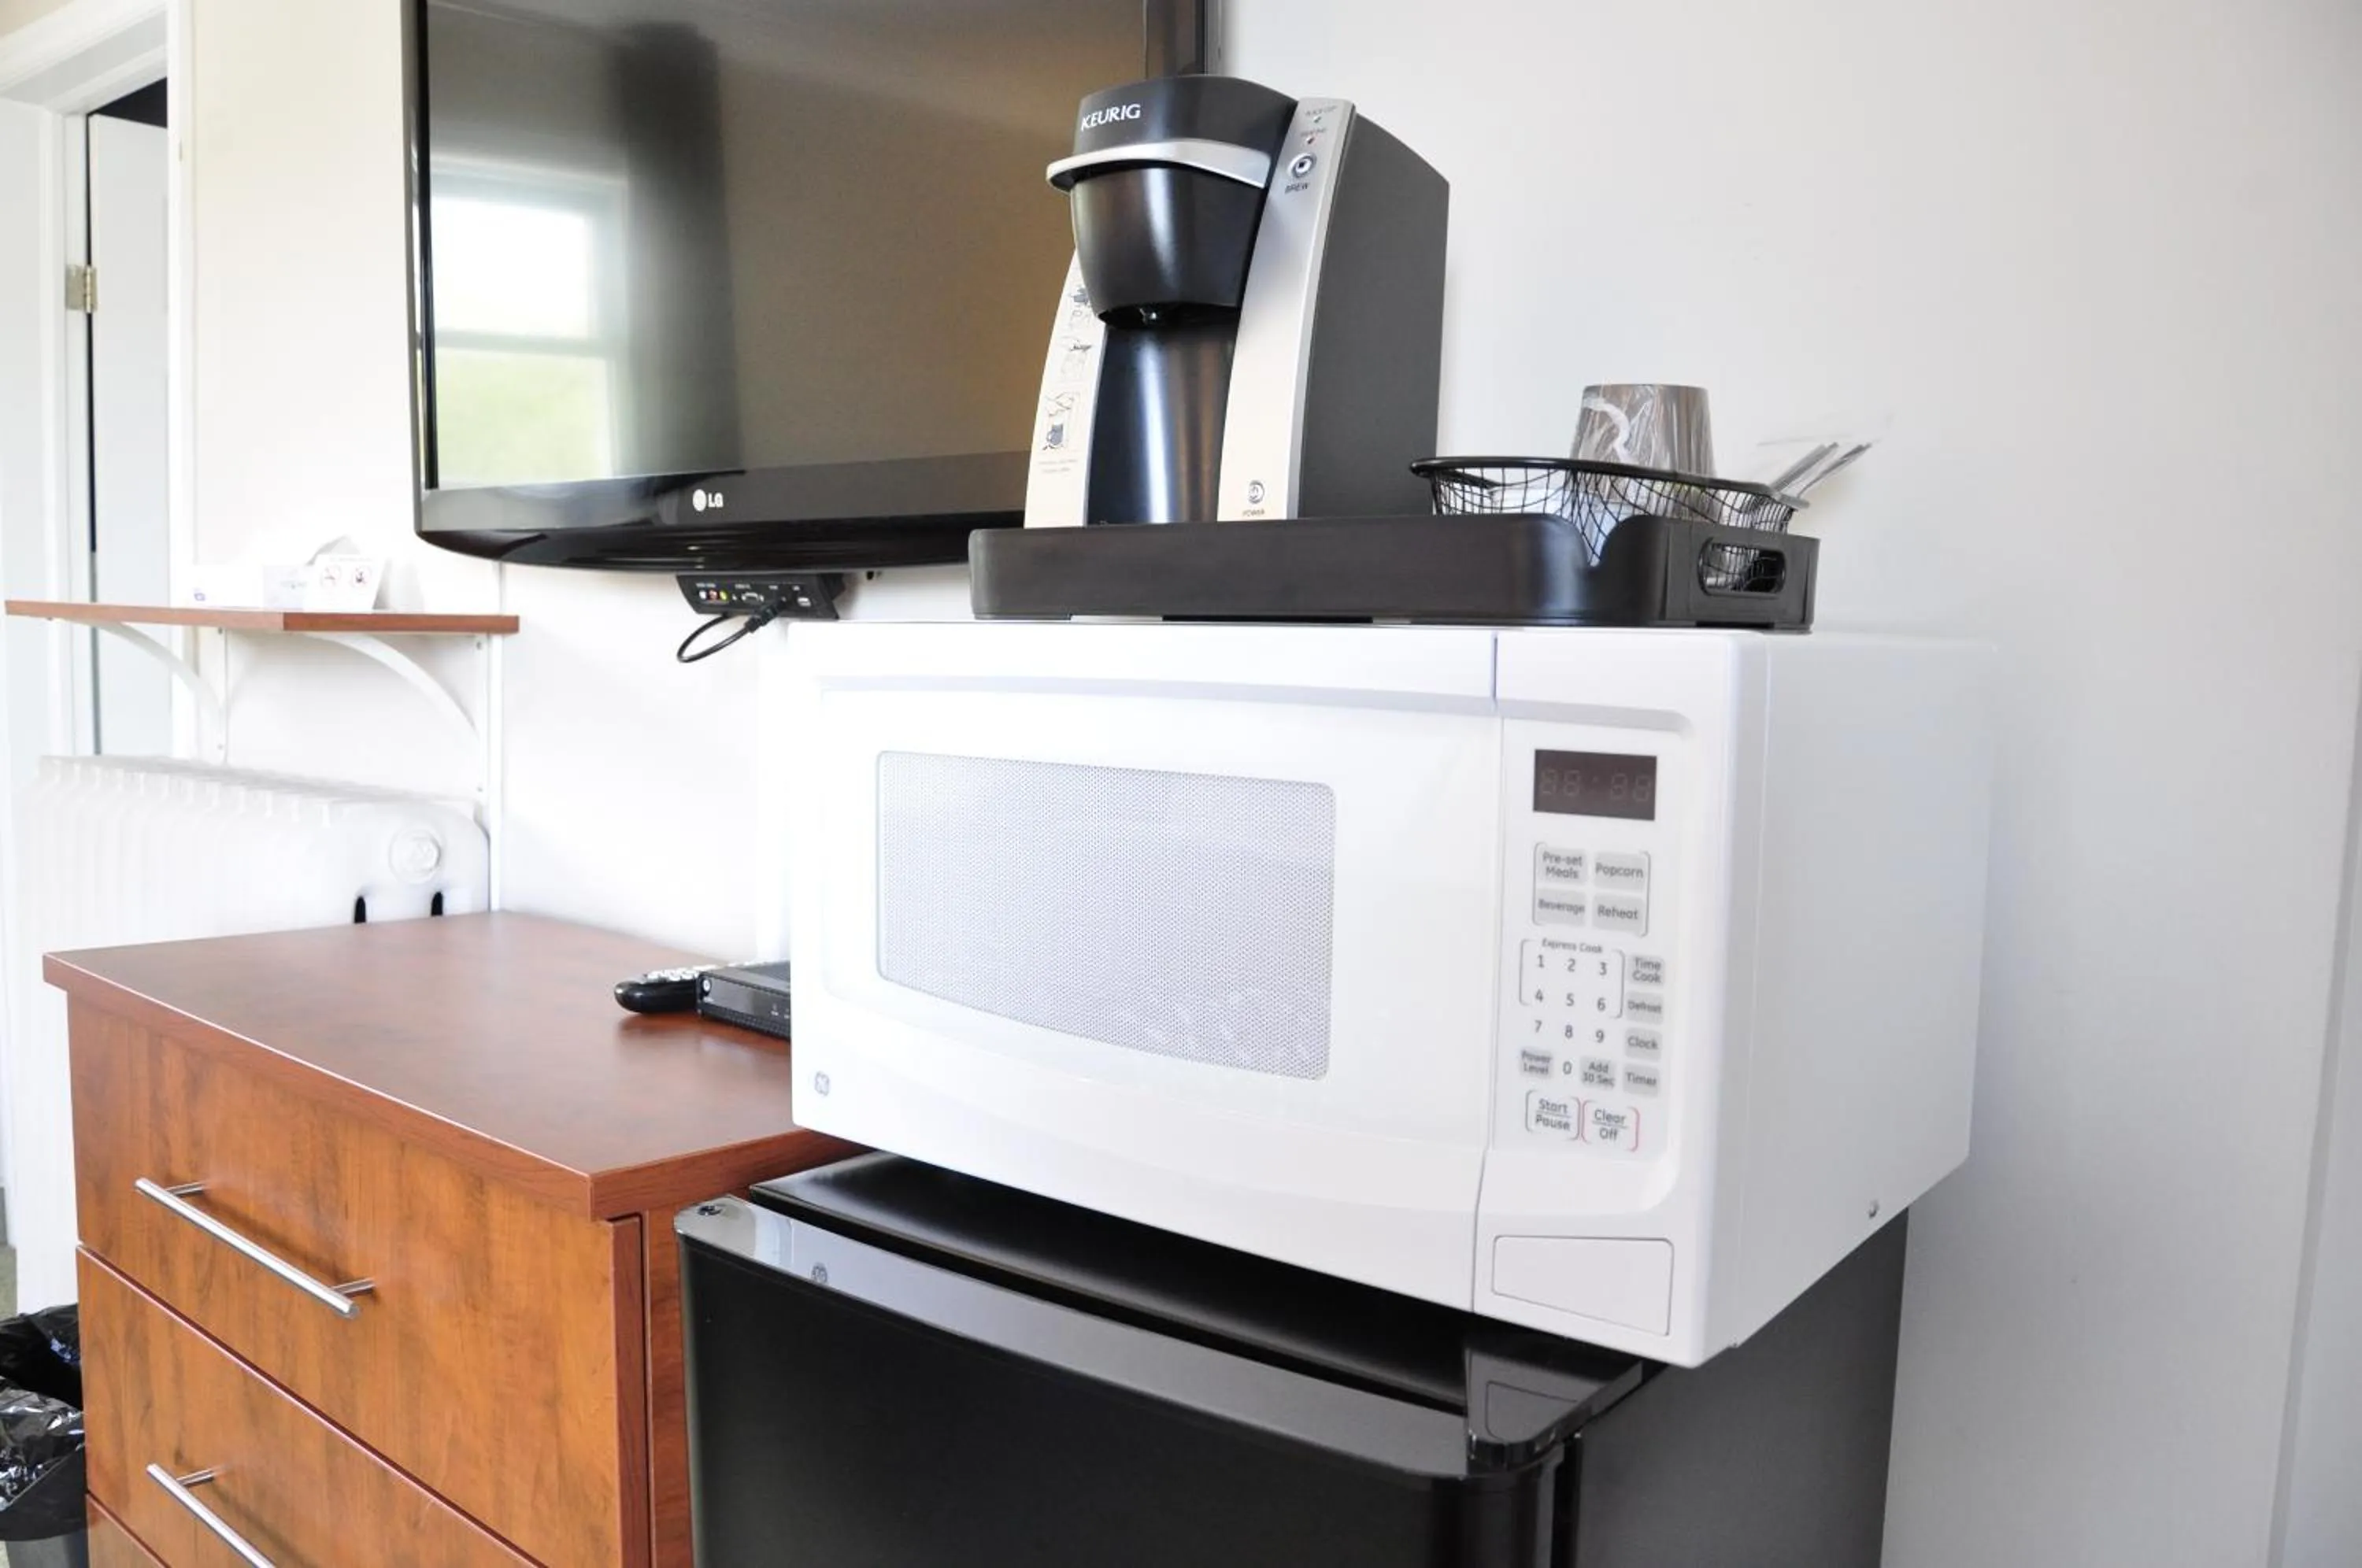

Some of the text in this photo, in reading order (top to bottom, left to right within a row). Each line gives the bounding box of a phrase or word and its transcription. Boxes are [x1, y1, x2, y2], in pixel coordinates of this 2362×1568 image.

[1080, 103, 1141, 132] KEURIG
[1542, 851, 1583, 867] Pre-set
[1546, 866, 1579, 878] Meals
[1595, 863, 1644, 878] Popcorn
[1538, 899, 1586, 915] Beverage
[1597, 904, 1638, 919] Reheat
[1542, 937, 1603, 953] Express Cook
[1537, 955, 1607, 975] 1 2 3
[1635, 957, 1661, 971] Time
[1632, 971, 1661, 983] Cook
[1535, 989, 1606, 1011] 4 5 6
[1535, 1020, 1604, 1043] 7 8 9
[1627, 1036, 1658, 1050] Clock
[1521, 1050, 1551, 1063] Power
[1523, 1062, 1549, 1074] Level
[1563, 1061, 1572, 1074] 0
[1588, 1061, 1609, 1074] Add
[1538, 1098, 1568, 1114] Start
[1535, 1114, 1571, 1131] Pause
[1594, 1108, 1627, 1125] Clear
[1599, 1127, 1618, 1141] Off
